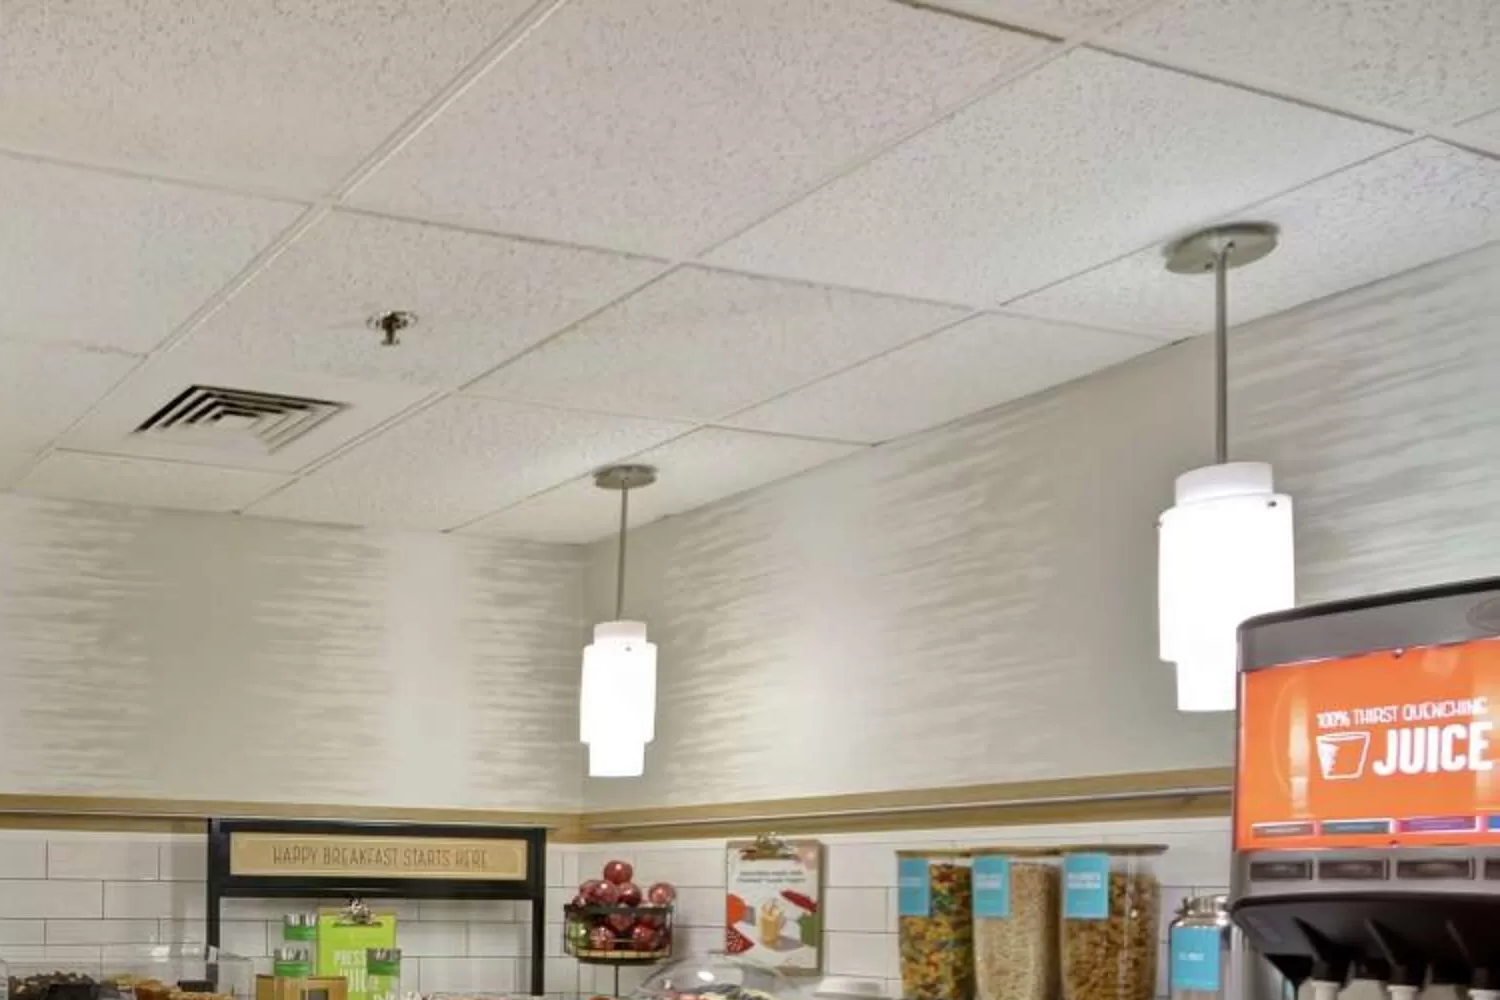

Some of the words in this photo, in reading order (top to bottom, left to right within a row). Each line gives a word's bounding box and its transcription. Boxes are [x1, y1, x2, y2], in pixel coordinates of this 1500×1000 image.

[1316, 711, 1350, 729] 100%
[1353, 704, 1399, 725] THIRST
[1403, 697, 1488, 721] QUENCHING
[1372, 720, 1494, 776] JUICE
[272, 844, 318, 865] HAPPY
[322, 846, 400, 867] BREAKFAST
[402, 848, 451, 867] STARTS
[455, 849, 489, 868] HERE
